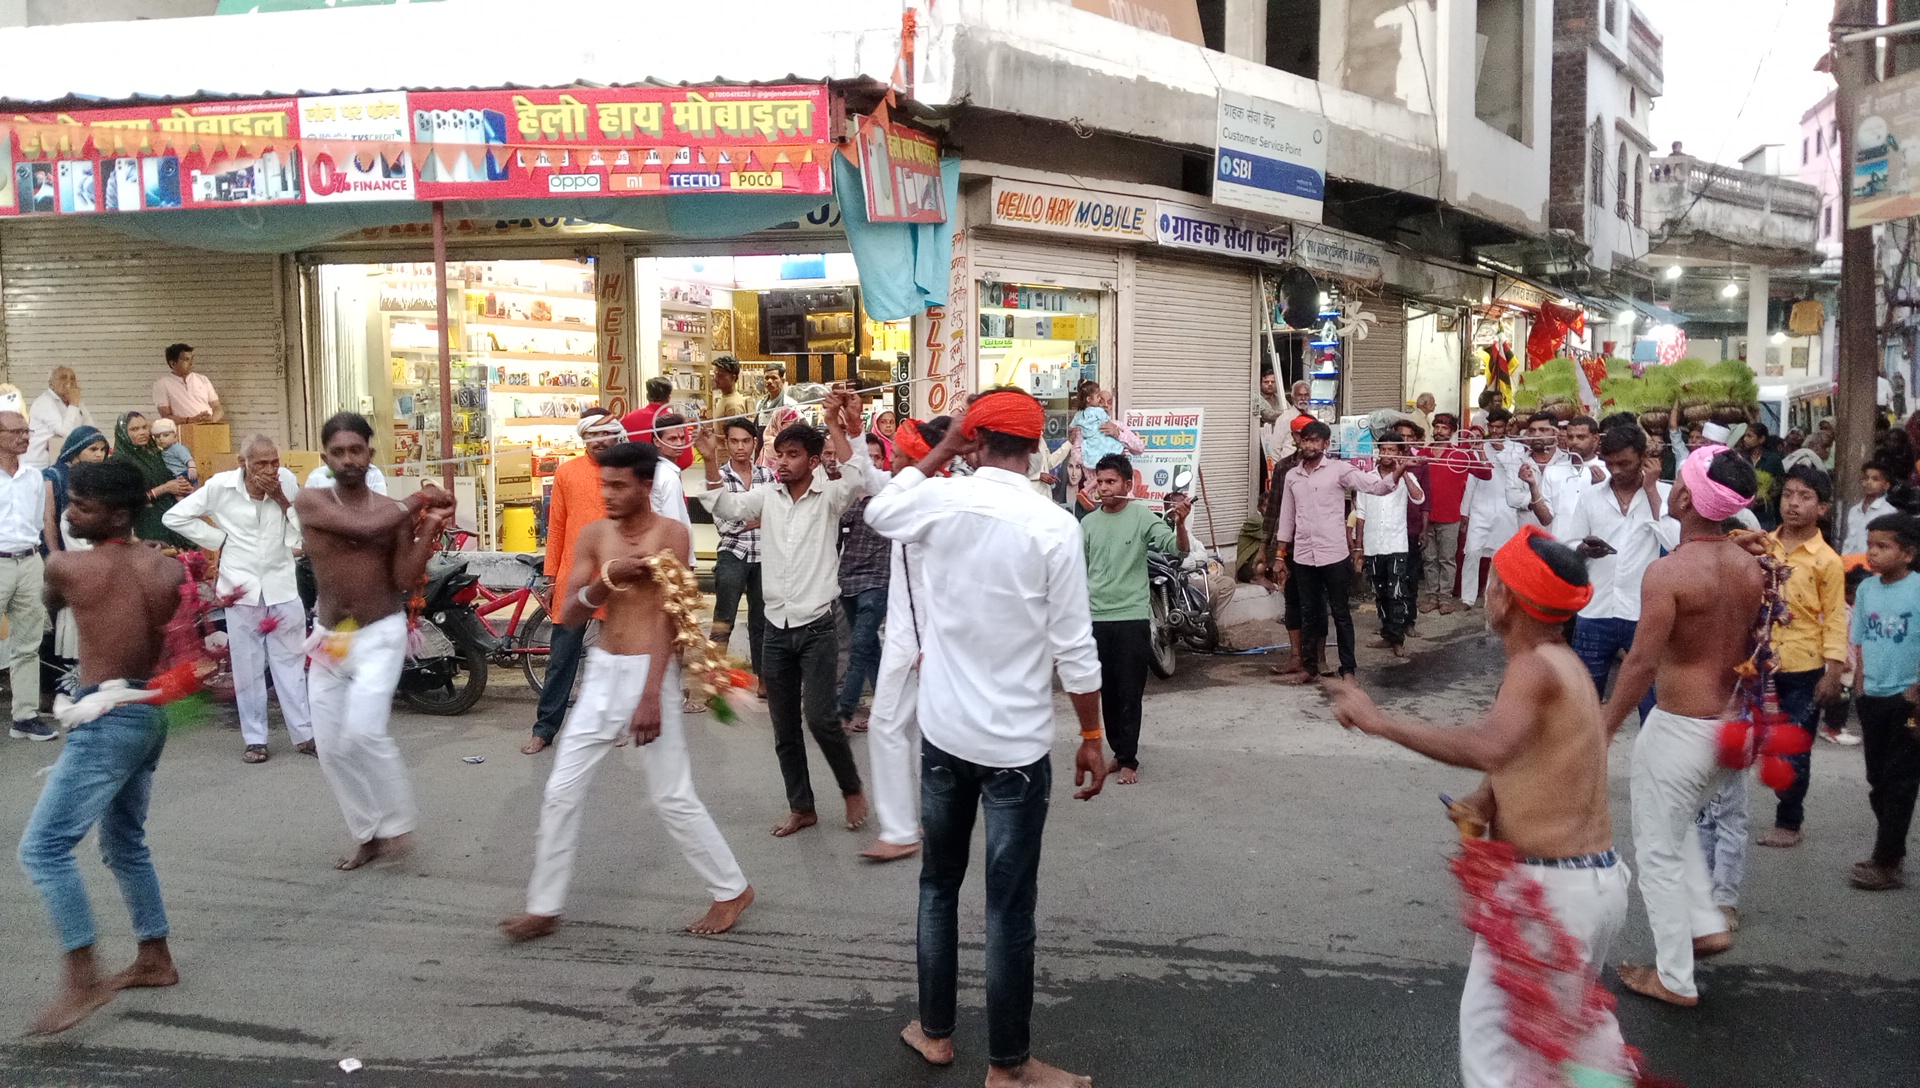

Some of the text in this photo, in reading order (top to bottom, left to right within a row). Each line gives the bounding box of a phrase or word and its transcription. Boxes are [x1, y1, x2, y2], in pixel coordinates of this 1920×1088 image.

[512, 91, 813, 138] हेलो हाय मोबाइल
[1223, 103, 1244, 120] ग्राहक
[1246, 106, 1261, 125] सेवा
[1222, 126, 1302, 157] Customer Service Point
[1232, 157, 1252, 180] SBI
[353, 180, 408, 191] FINANCE
[669, 174, 720, 189] TECNO
[739, 174, 774, 187] POCO
[996, 190, 1045, 223] HELLO
[1074, 200, 1147, 234] MOBILE
[1172, 215, 1222, 246] ग्राहक
[1223, 218, 1255, 252] सेवा
[1256, 225, 1289, 258] केन्द्र
[602, 273, 630, 420] HELLO
[1126, 411, 1199, 428] हेलो हाय मोबाइल
[1152, 433, 1168, 446] पर
[1170, 430, 1195, 447] फोन
